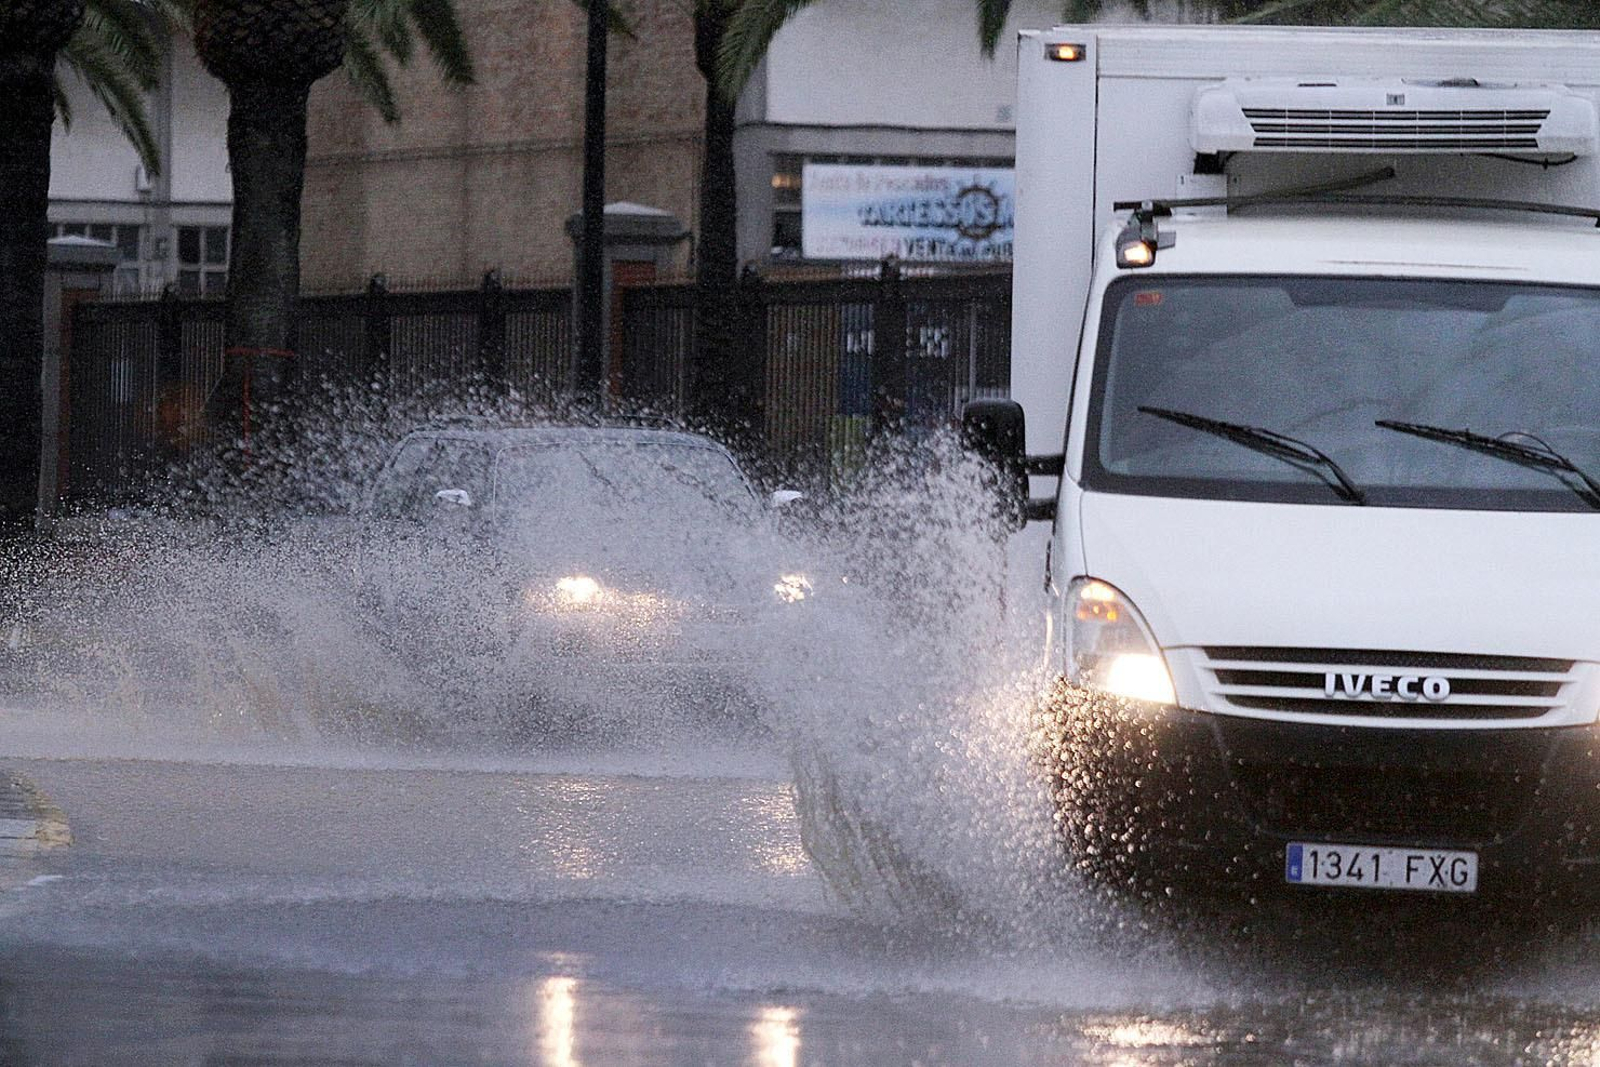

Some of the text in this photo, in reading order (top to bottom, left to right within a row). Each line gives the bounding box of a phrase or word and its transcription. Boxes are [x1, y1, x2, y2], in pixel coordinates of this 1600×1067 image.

[1324, 672, 1451, 702] IVECO
[1309, 850, 1380, 882] 1341
[1406, 855, 1468, 886] FXG
